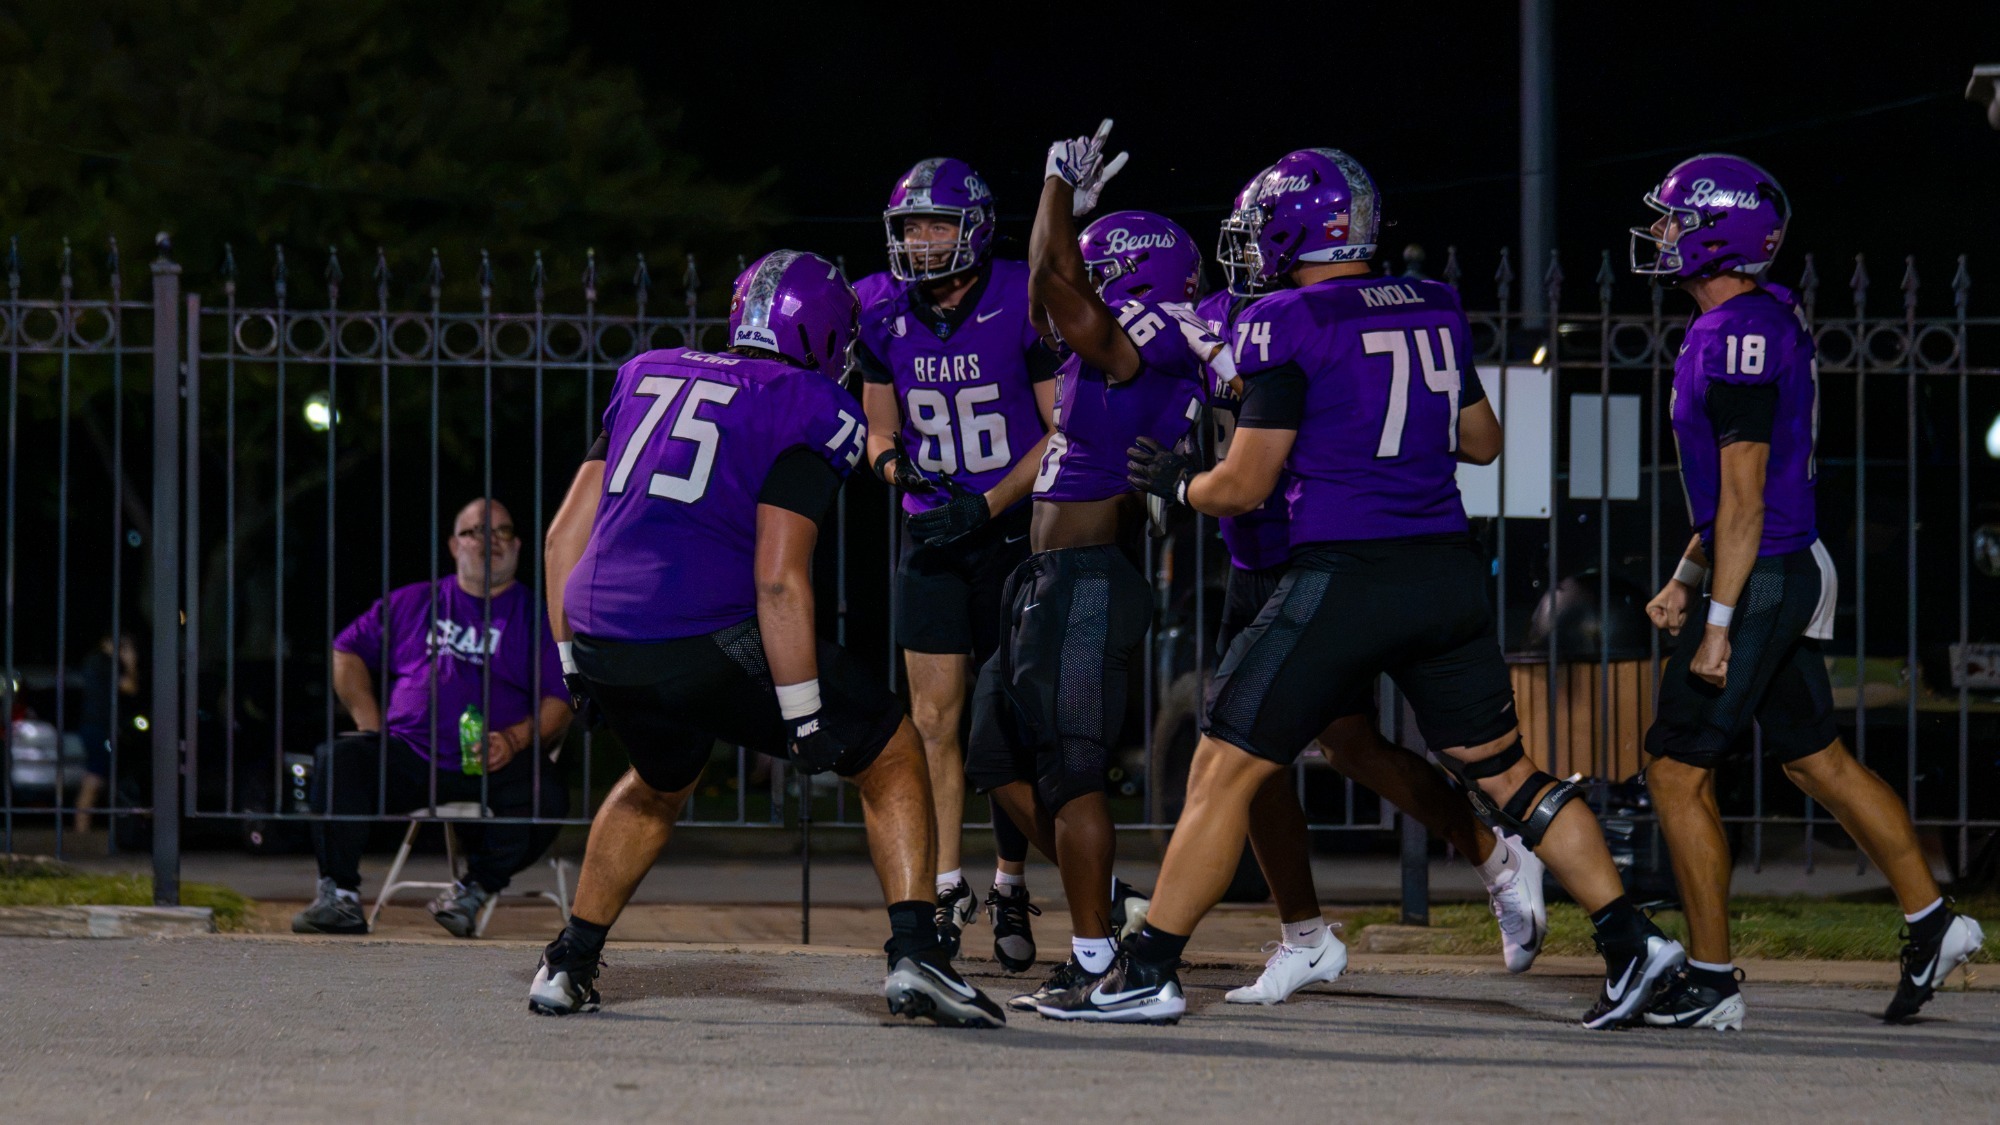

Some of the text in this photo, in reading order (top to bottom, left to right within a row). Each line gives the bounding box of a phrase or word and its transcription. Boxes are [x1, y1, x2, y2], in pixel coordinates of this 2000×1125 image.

[1257, 171, 1311, 202] Bears
[1683, 178, 1760, 210] Bears
[1103, 228, 1177, 256] Bears
[1328, 247, 1358, 261] Roll
[1357, 283, 1425, 308] KNOLL
[735, 330, 776, 346] Roll Bears
[1234, 321, 1271, 364] 74
[914, 353, 981, 382] BEARS
[1725, 334, 1766, 375] 18
[1361, 326, 1462, 460] 74
[607, 375, 741, 504] 75
[824, 408, 867, 468] 75
[906, 382, 1012, 475] 86
[796, 719, 820, 738] NIKE
